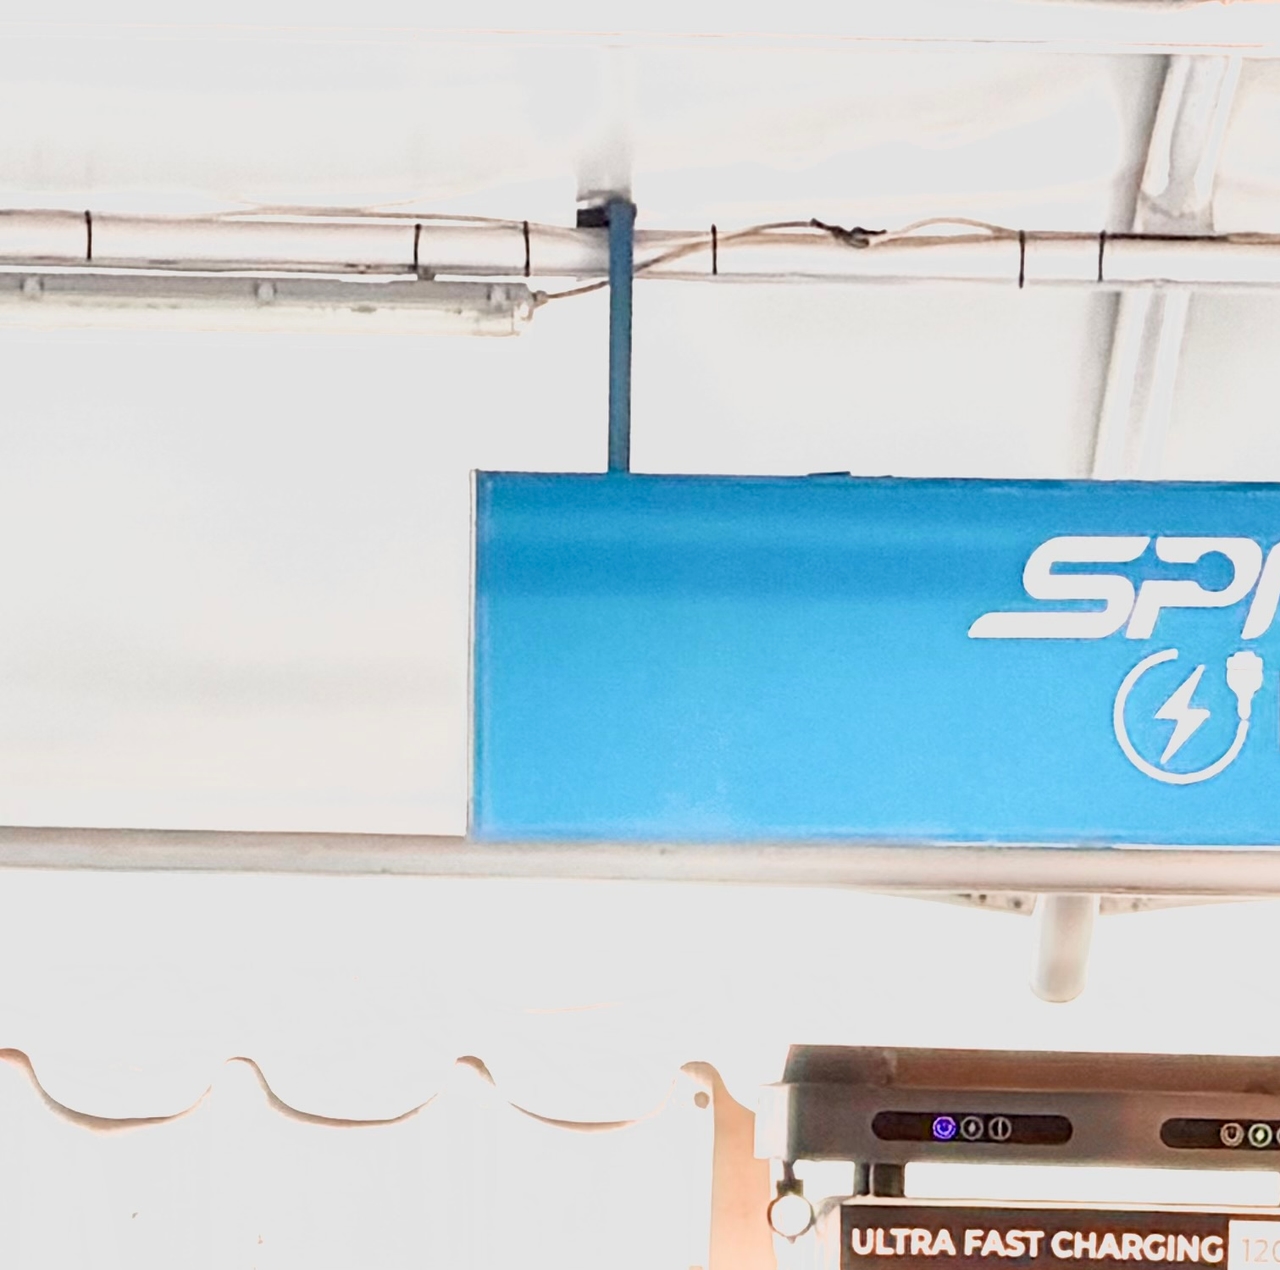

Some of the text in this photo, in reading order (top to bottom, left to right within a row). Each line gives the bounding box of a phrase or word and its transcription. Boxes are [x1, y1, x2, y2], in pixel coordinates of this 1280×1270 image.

[852, 1227, 1223, 1264] ULTRA FAST CHARGING
